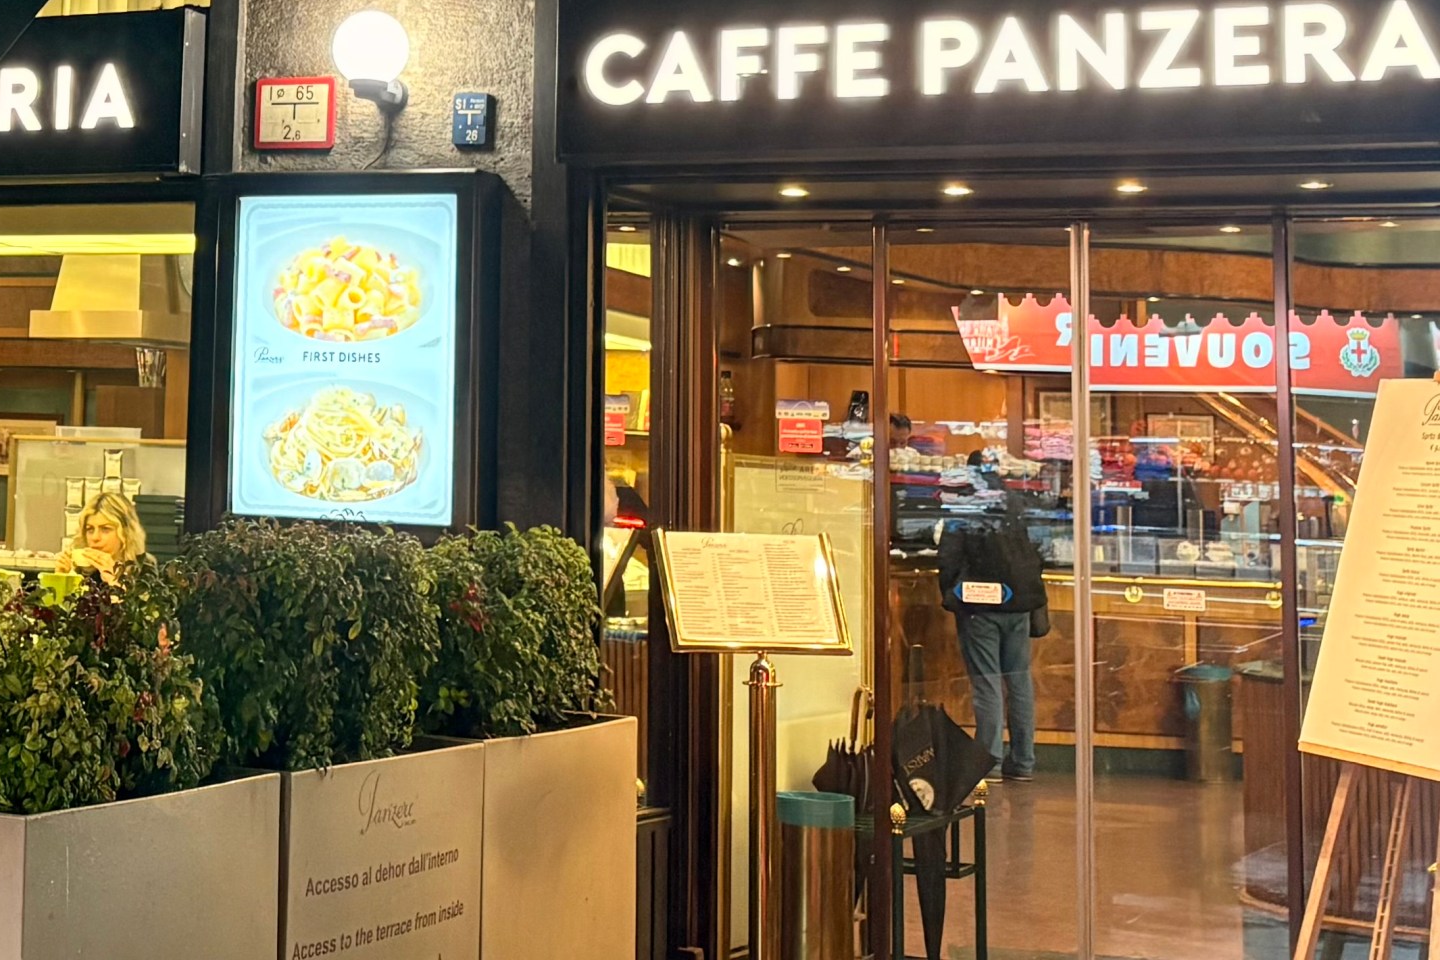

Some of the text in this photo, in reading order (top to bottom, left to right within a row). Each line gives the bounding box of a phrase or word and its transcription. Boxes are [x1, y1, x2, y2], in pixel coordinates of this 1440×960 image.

[585, 22, 891, 106] CAFFE
[295, 85, 314, 101] 65
[465, 129, 478, 141] 26
[302, 351, 382, 364] FIRST DISHES
[305, 848, 459, 897] Accesso al dehor dall'interno
[291, 899, 464, 960] Access to the terrace from inside
